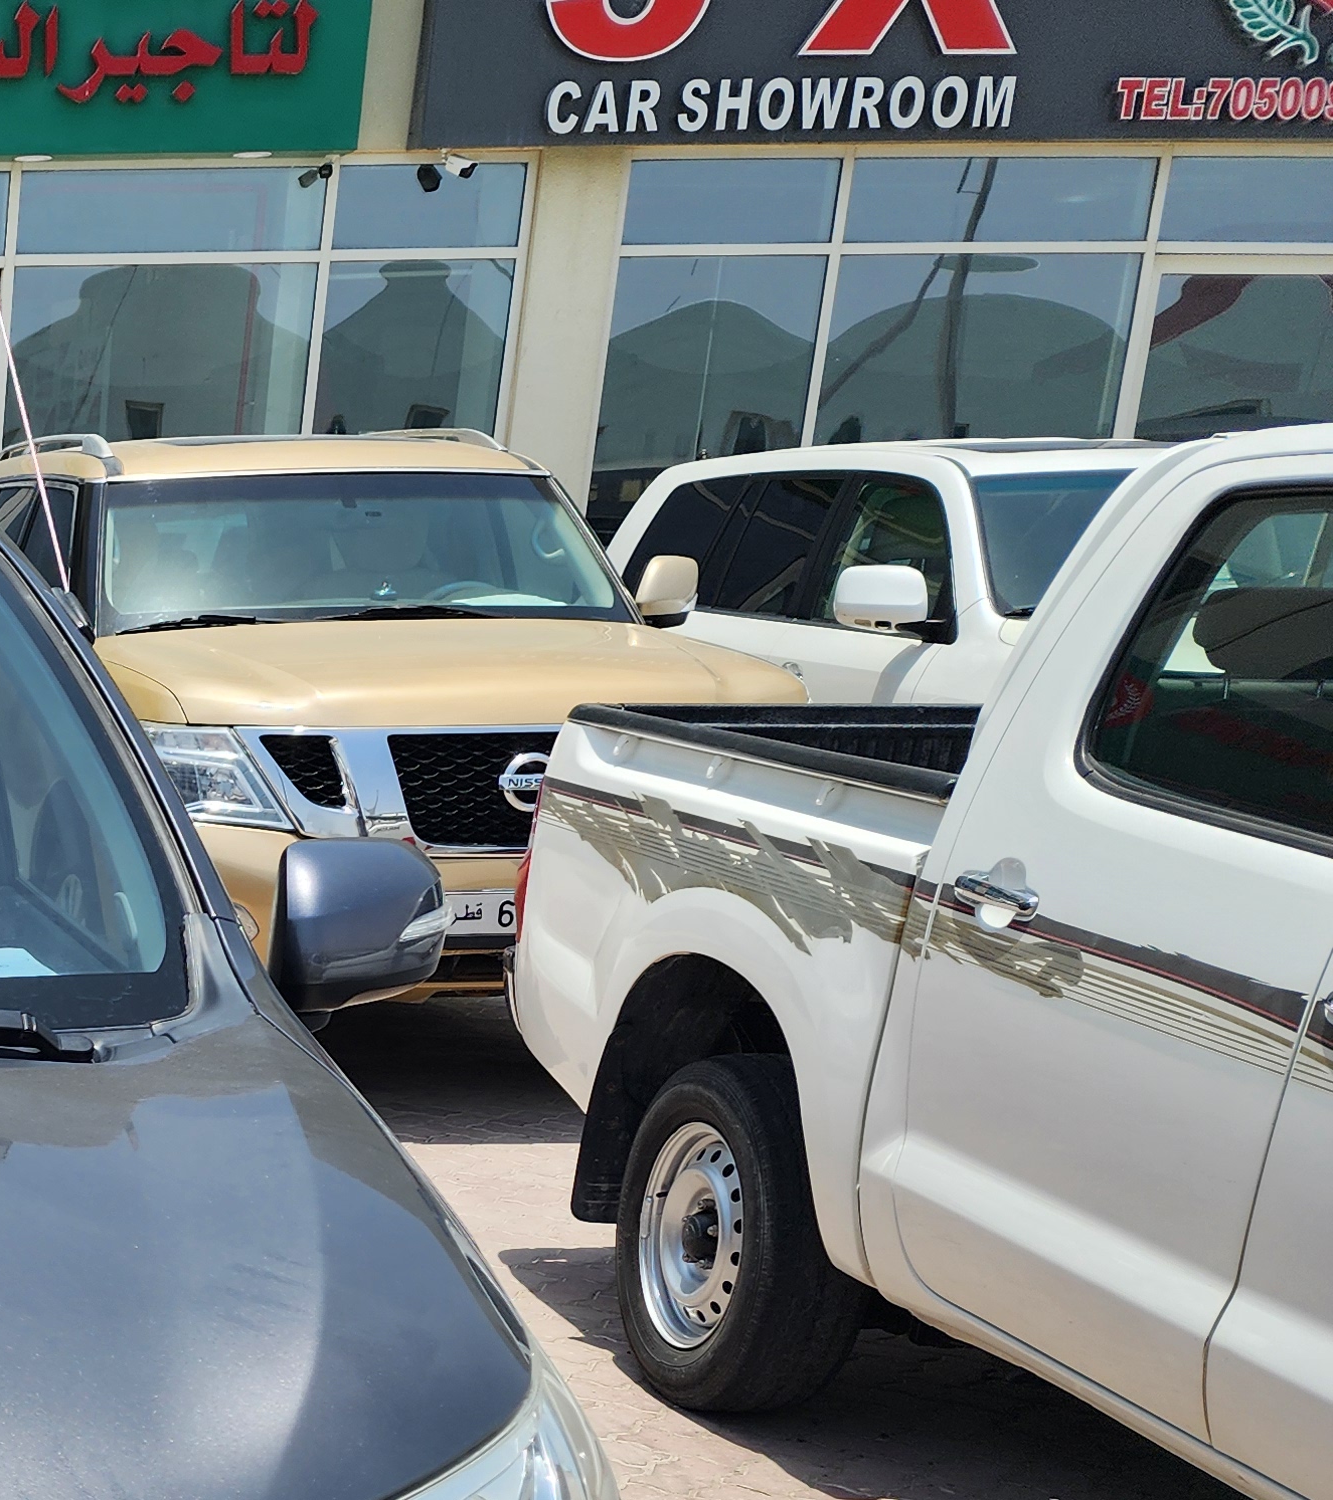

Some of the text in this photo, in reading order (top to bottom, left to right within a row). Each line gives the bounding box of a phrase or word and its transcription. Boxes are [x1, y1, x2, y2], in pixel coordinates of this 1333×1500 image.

[546, 76, 1017, 135] CAR SHOWROOM
[508, 777, 543, 788] NISS
[450, 902, 483, 926] قطر
